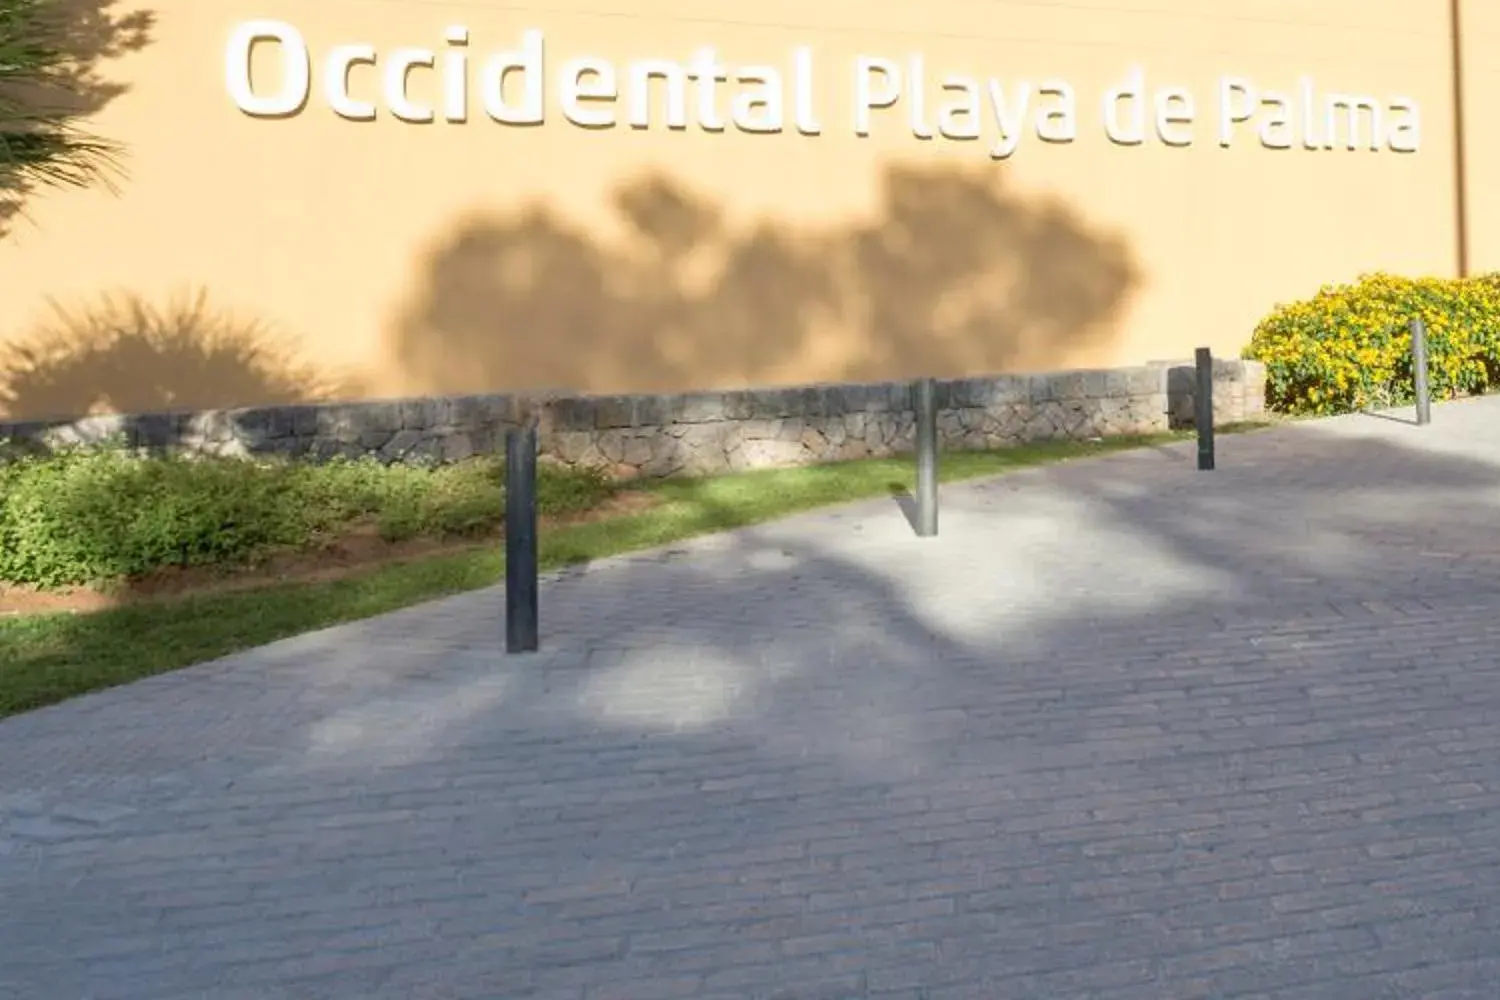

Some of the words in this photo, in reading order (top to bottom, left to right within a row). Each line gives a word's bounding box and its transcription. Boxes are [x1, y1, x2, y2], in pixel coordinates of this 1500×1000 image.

[223, 18, 821, 137] Occidental
[853, 54, 1077, 160] Playa
[1102, 65, 1195, 147] de
[1218, 74, 1420, 153] Palma
